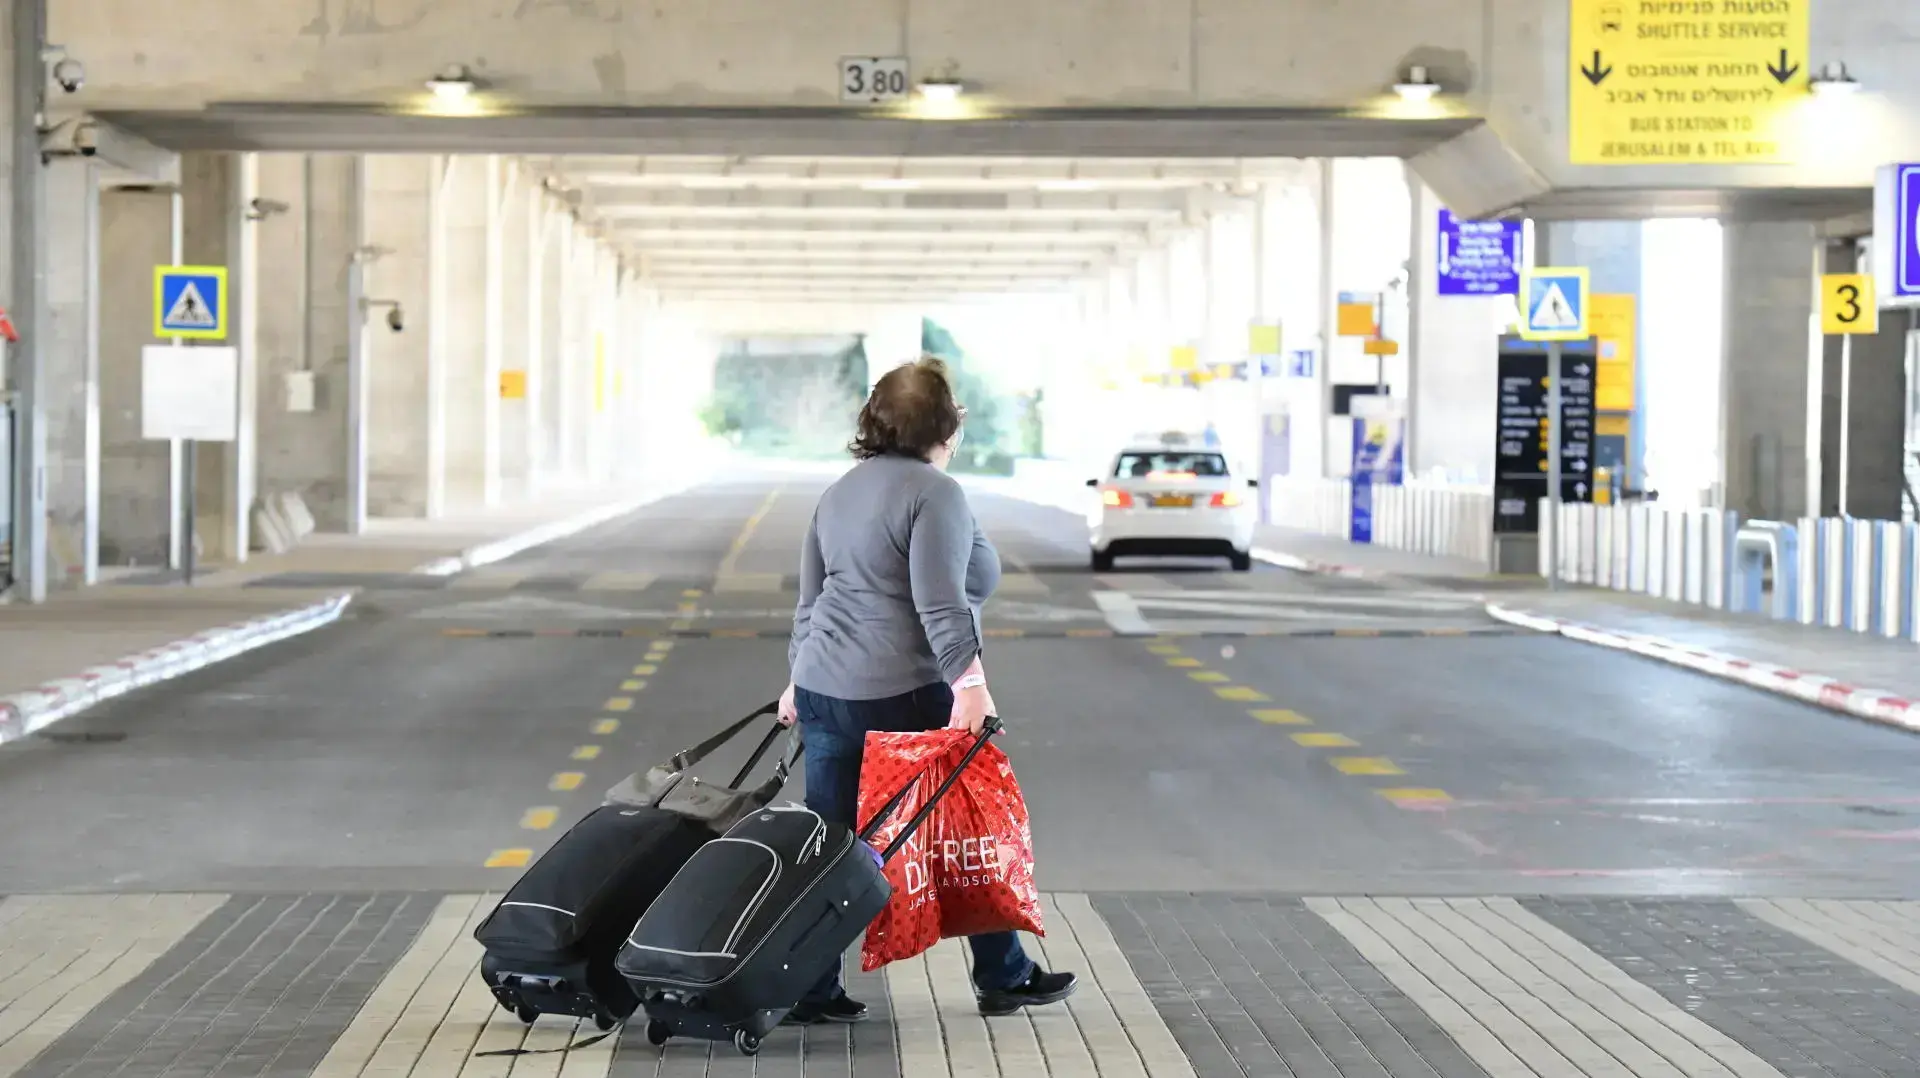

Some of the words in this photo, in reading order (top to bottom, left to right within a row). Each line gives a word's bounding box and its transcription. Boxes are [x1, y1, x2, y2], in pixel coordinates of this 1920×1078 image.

[1636, 22, 1710, 39] SHUTTLE
[1717, 22, 1788, 39] SERVICE
[1626, 63, 1699, 78] אוטובוס
[1706, 63, 1760, 77] תחנת
[1605, 89, 1647, 104] אביב
[1653, 87, 1686, 104] ותל
[1691, 87, 1775, 104] לירושלים
[1629, 116, 1661, 133] BUS
[1664, 116, 1729, 133] STATION
[1733, 116, 1753, 133] TO
[1600, 140, 1691, 158] JERUSALEM
[1713, 140, 1738, 158] TEL
[1743, 140, 1777, 156] AV
[1836, 284, 1861, 323] 3
